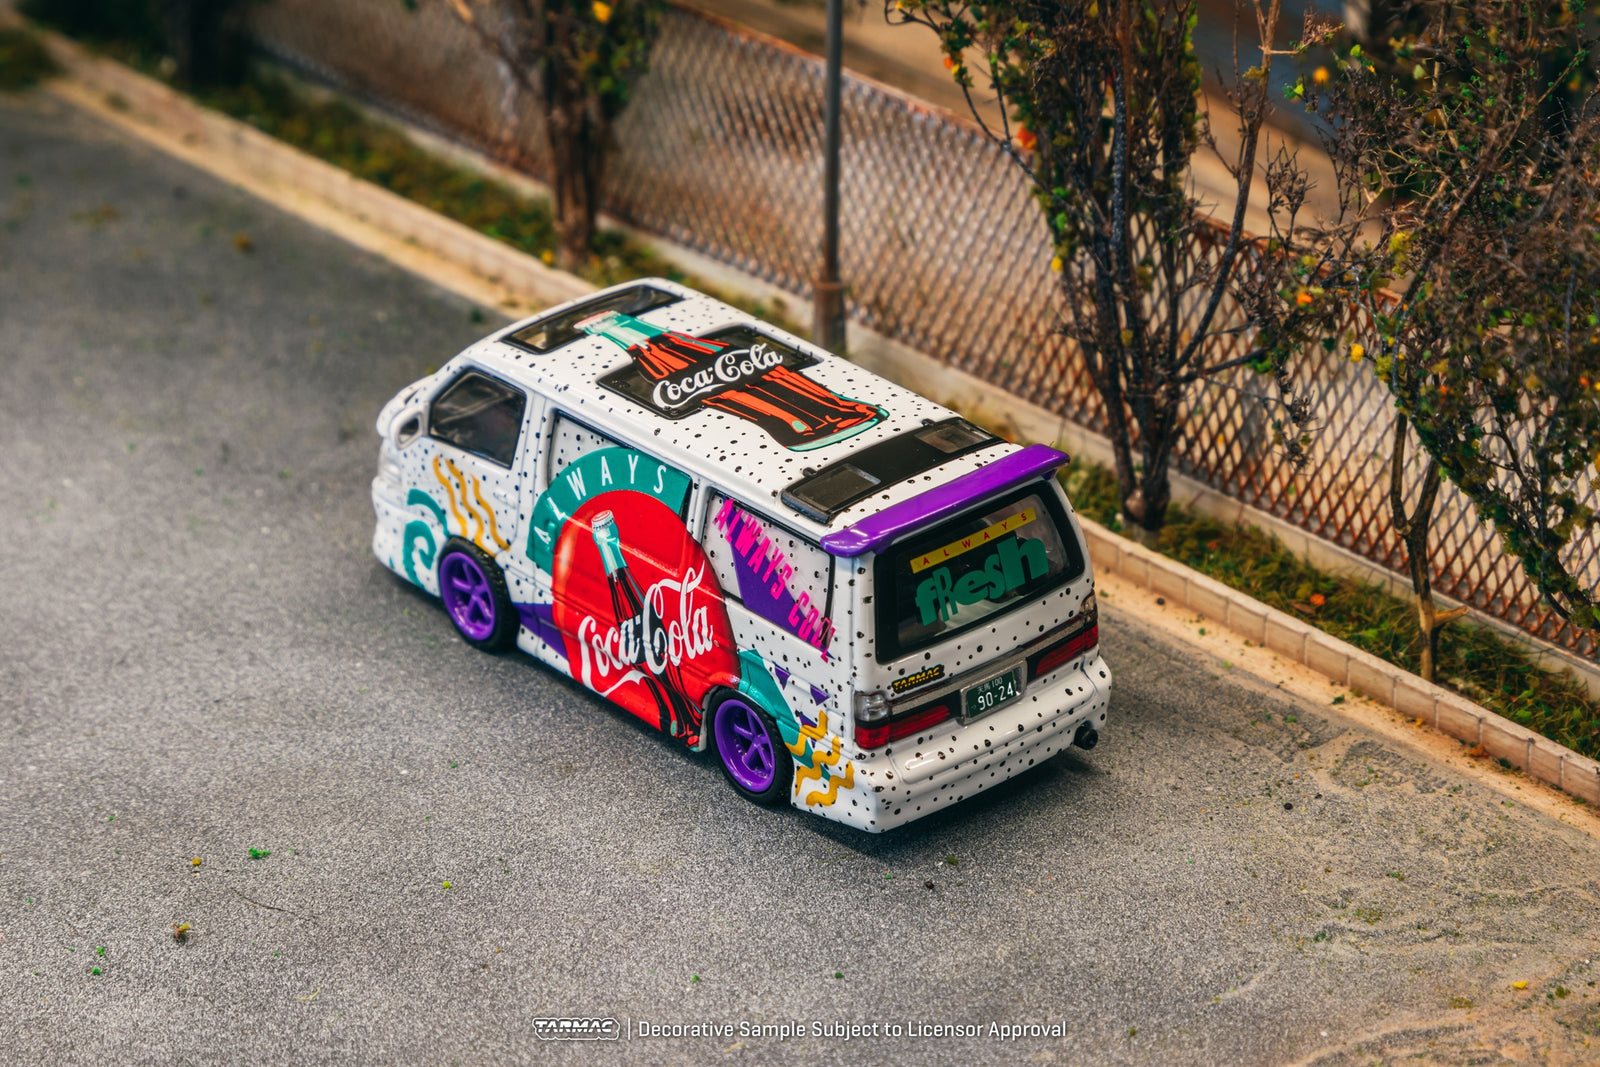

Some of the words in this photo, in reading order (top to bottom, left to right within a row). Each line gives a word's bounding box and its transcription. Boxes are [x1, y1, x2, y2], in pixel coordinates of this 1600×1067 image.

[652, 343, 784, 409] Coca-Cola
[533, 454, 667, 545] ALWAYS
[713, 498, 793, 600] ALWAYS
[922, 513, 1028, 566] ALWAYS
[577, 560, 715, 697] Coca-Cola
[892, 665, 942, 691] TARMAC
[977, 681, 1014, 711] 90-24
